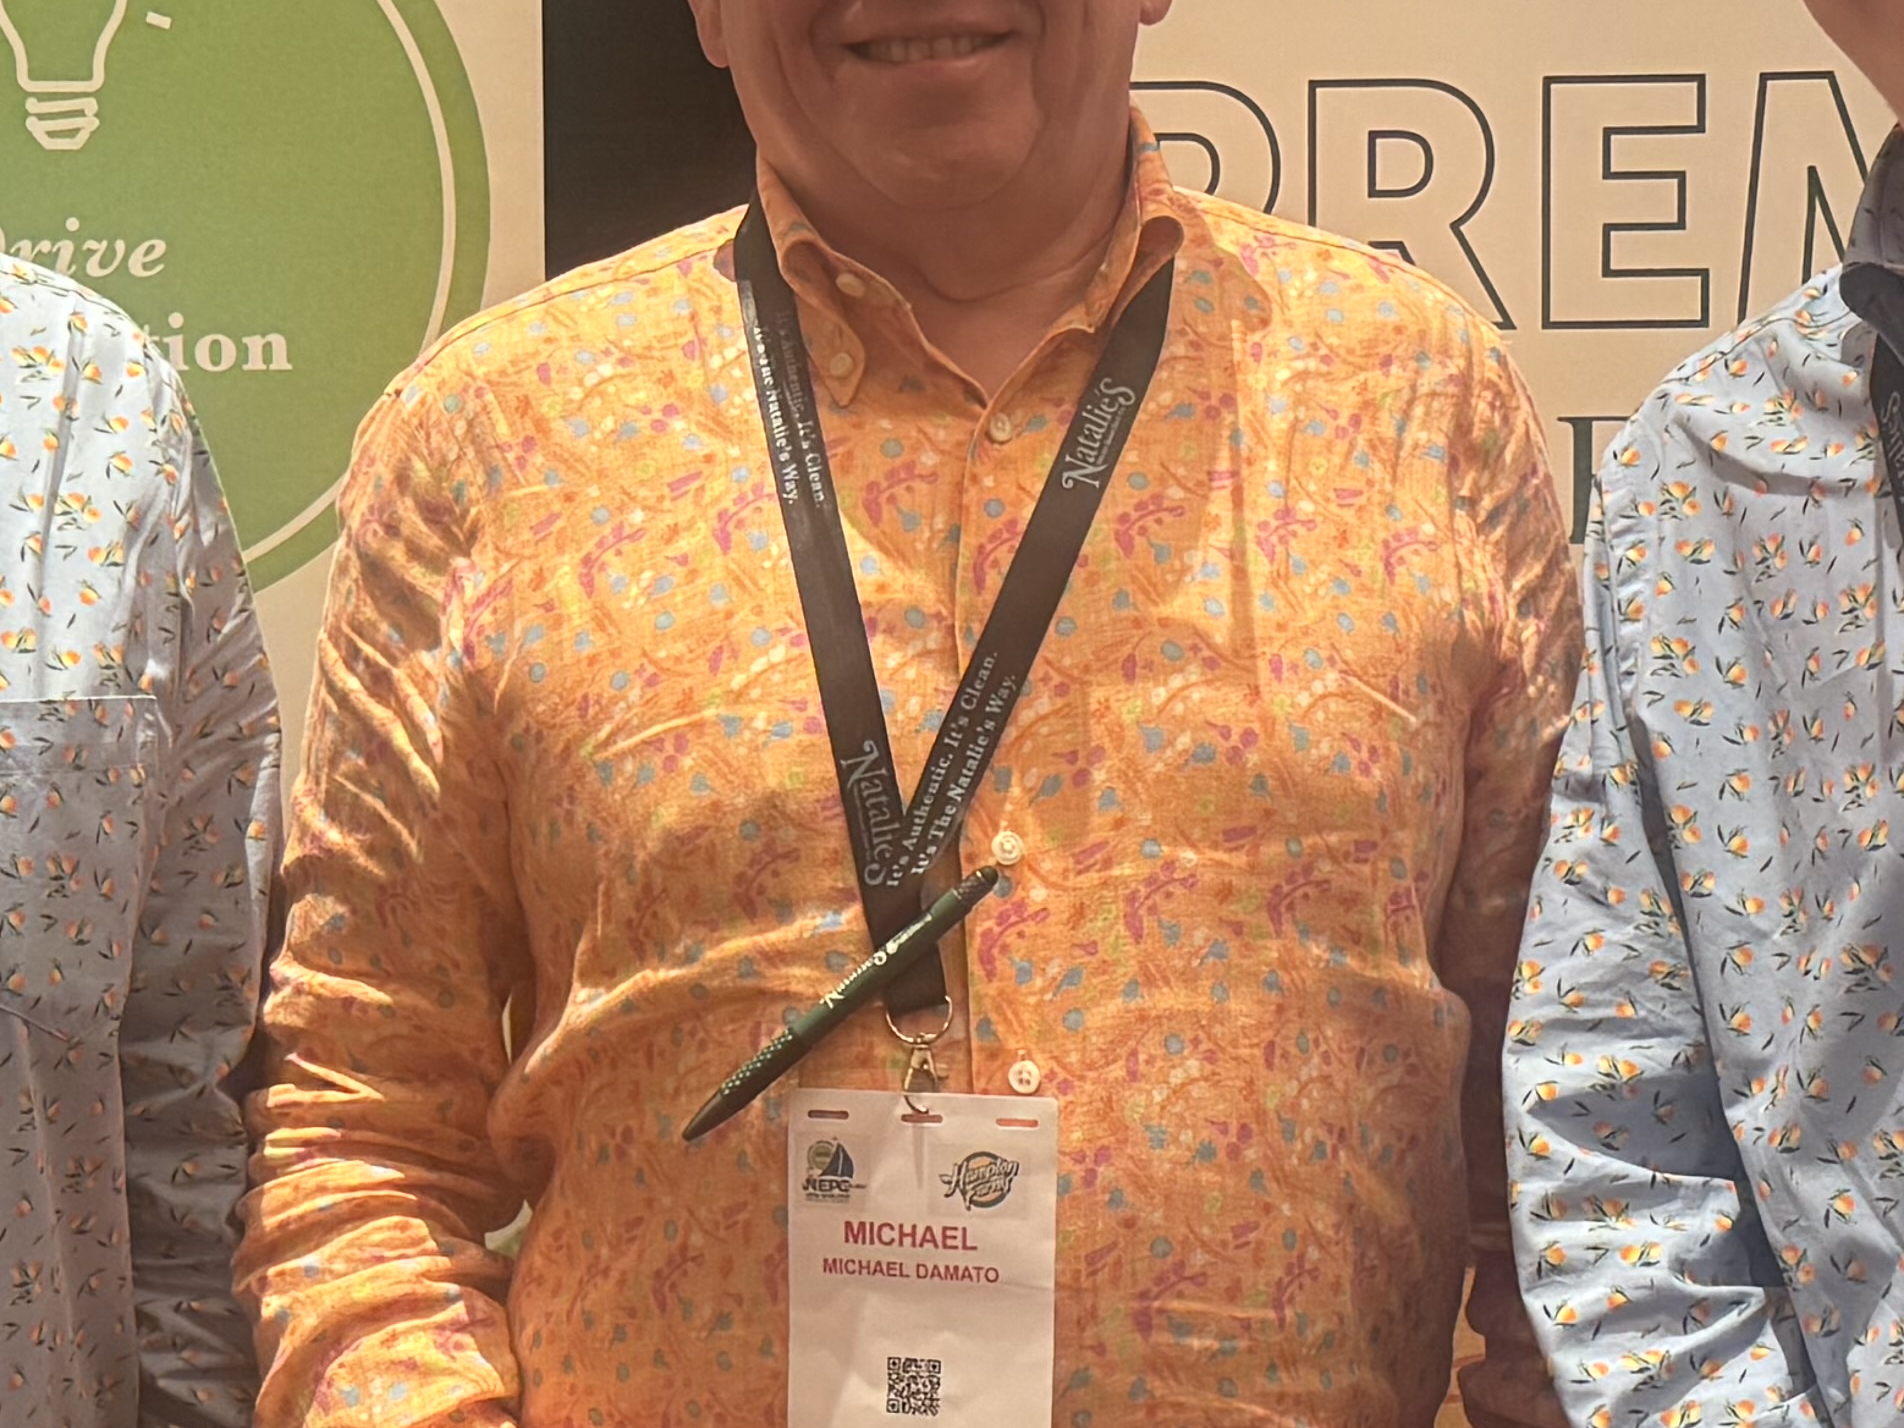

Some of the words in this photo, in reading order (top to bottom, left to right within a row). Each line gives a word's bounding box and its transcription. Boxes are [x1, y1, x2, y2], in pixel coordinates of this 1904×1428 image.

[902, 753, 955, 851] Authentic.
[944, 715, 970, 748] It's
[960, 651, 998, 711] Clean.
[928, 803, 957, 841] The
[947, 720, 996, 804] Natalie's
[985, 674, 1017, 715] Way.
[822, 1257, 911, 1279] MICHAEL
[916, 1262, 1000, 1283] DAMATO
[844, 1220, 978, 1251] MICHAEL
